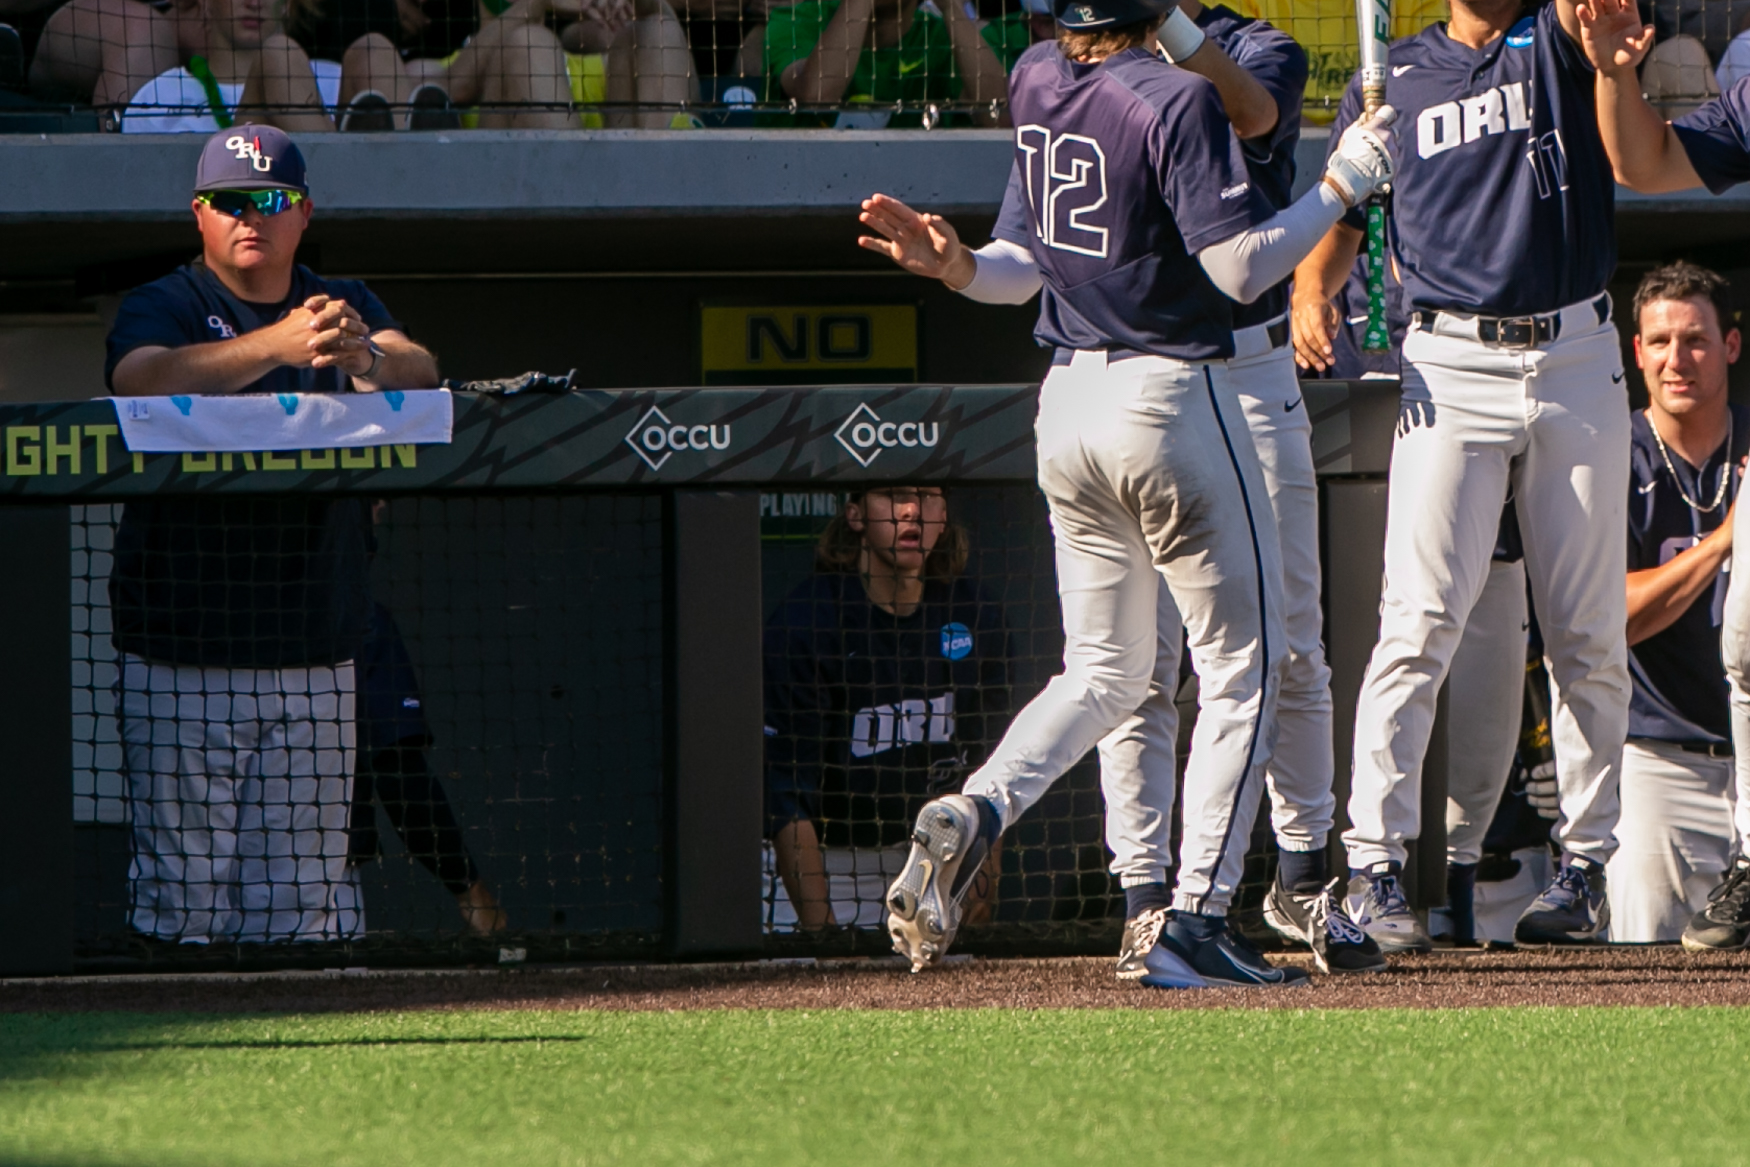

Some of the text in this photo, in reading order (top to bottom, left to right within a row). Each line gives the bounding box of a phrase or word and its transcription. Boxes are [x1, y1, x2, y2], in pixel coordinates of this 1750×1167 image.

[225, 136, 273, 173] ORU
[1017, 123, 1109, 259] 12
[746, 314, 873, 364] NO
[642, 423, 732, 452] OCCU
[851, 420, 940, 449] OCCU
[760, 491, 837, 520] PLAYING
